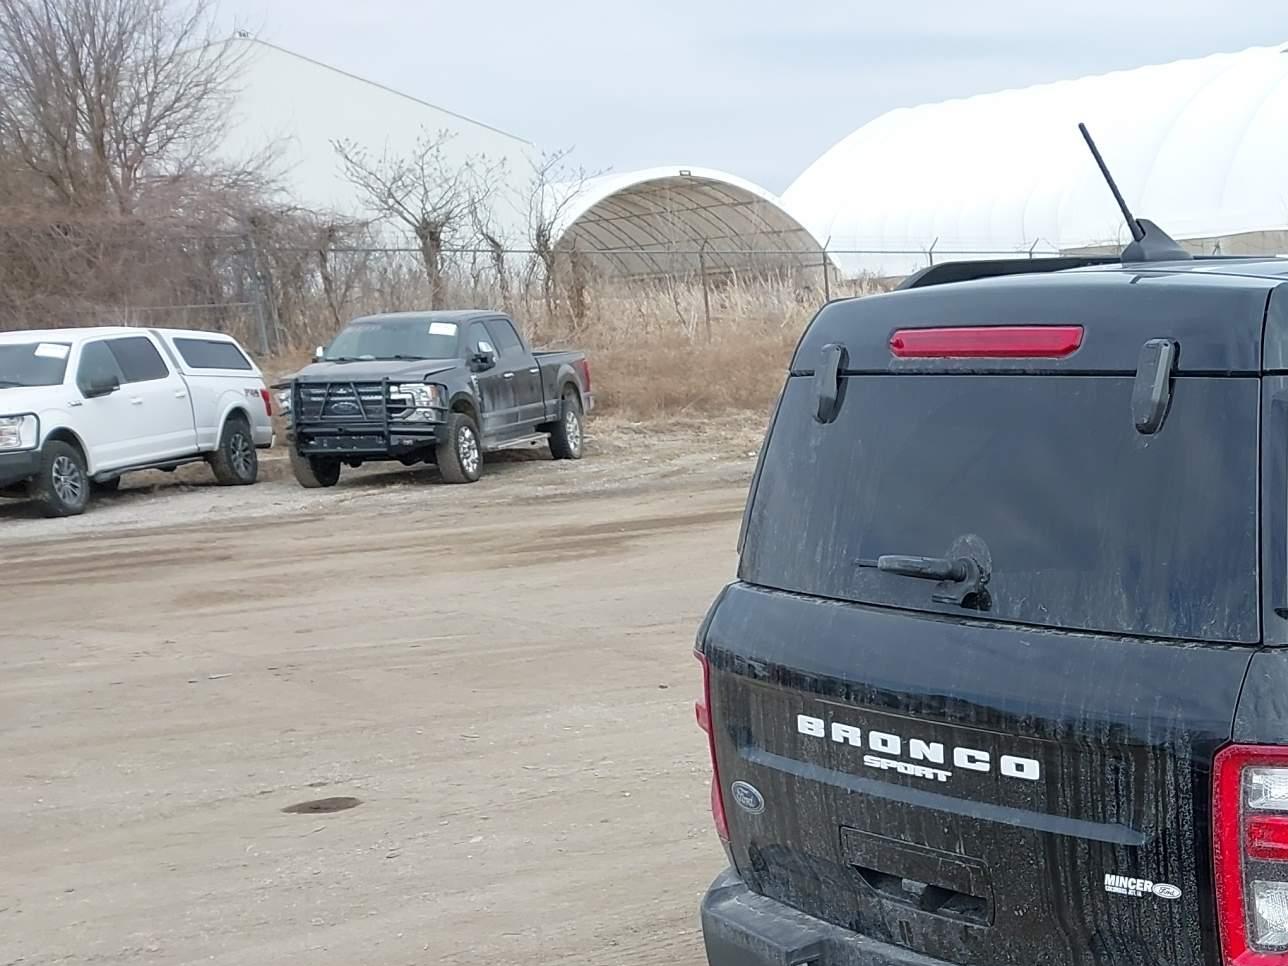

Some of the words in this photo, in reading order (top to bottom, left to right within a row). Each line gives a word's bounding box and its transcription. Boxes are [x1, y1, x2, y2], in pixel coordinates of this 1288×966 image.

[797, 714, 1040, 780] BRONCO
[863, 755, 952, 782] SPORT
[1104, 873, 1153, 893] MINCER
